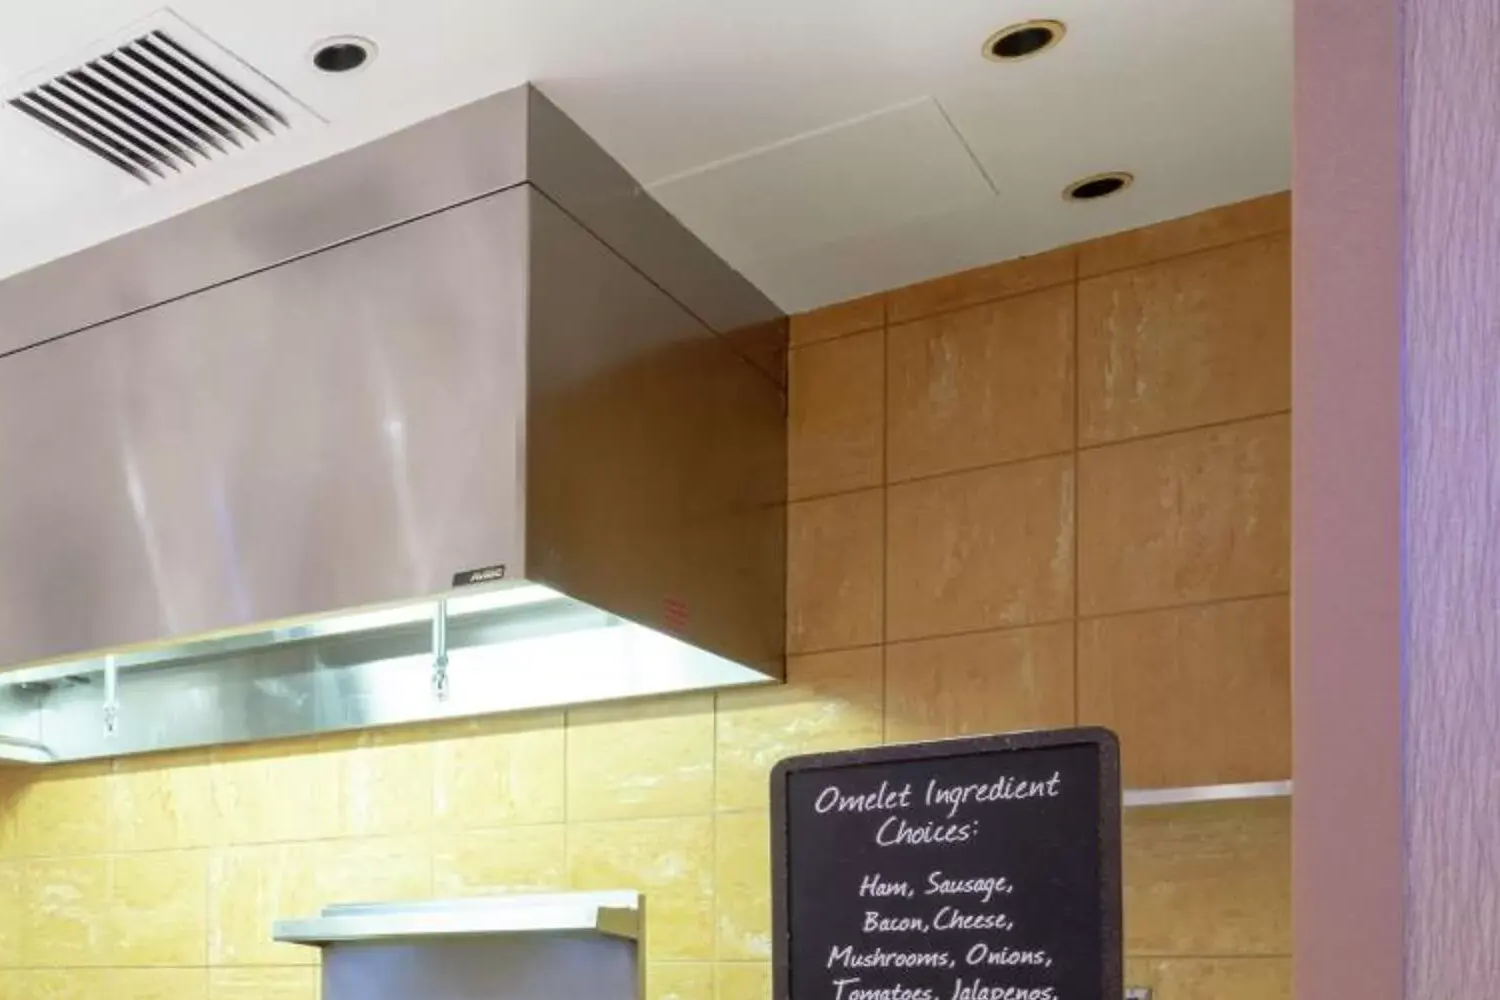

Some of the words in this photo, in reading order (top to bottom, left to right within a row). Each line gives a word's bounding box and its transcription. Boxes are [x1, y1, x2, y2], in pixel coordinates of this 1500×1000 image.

[815, 781, 911, 813] Omelet
[926, 772, 1061, 818] Ingredient
[876, 816, 979, 846] Choices:
[859, 874, 914, 897] Ham,
[925, 871, 1013, 902] Sausage,
[863, 911, 929, 933] Bacon,
[933, 906, 1014, 931] Cheese,
[827, 945, 955, 968] Mushrooms,
[966, 943, 1053, 967] Onions,
